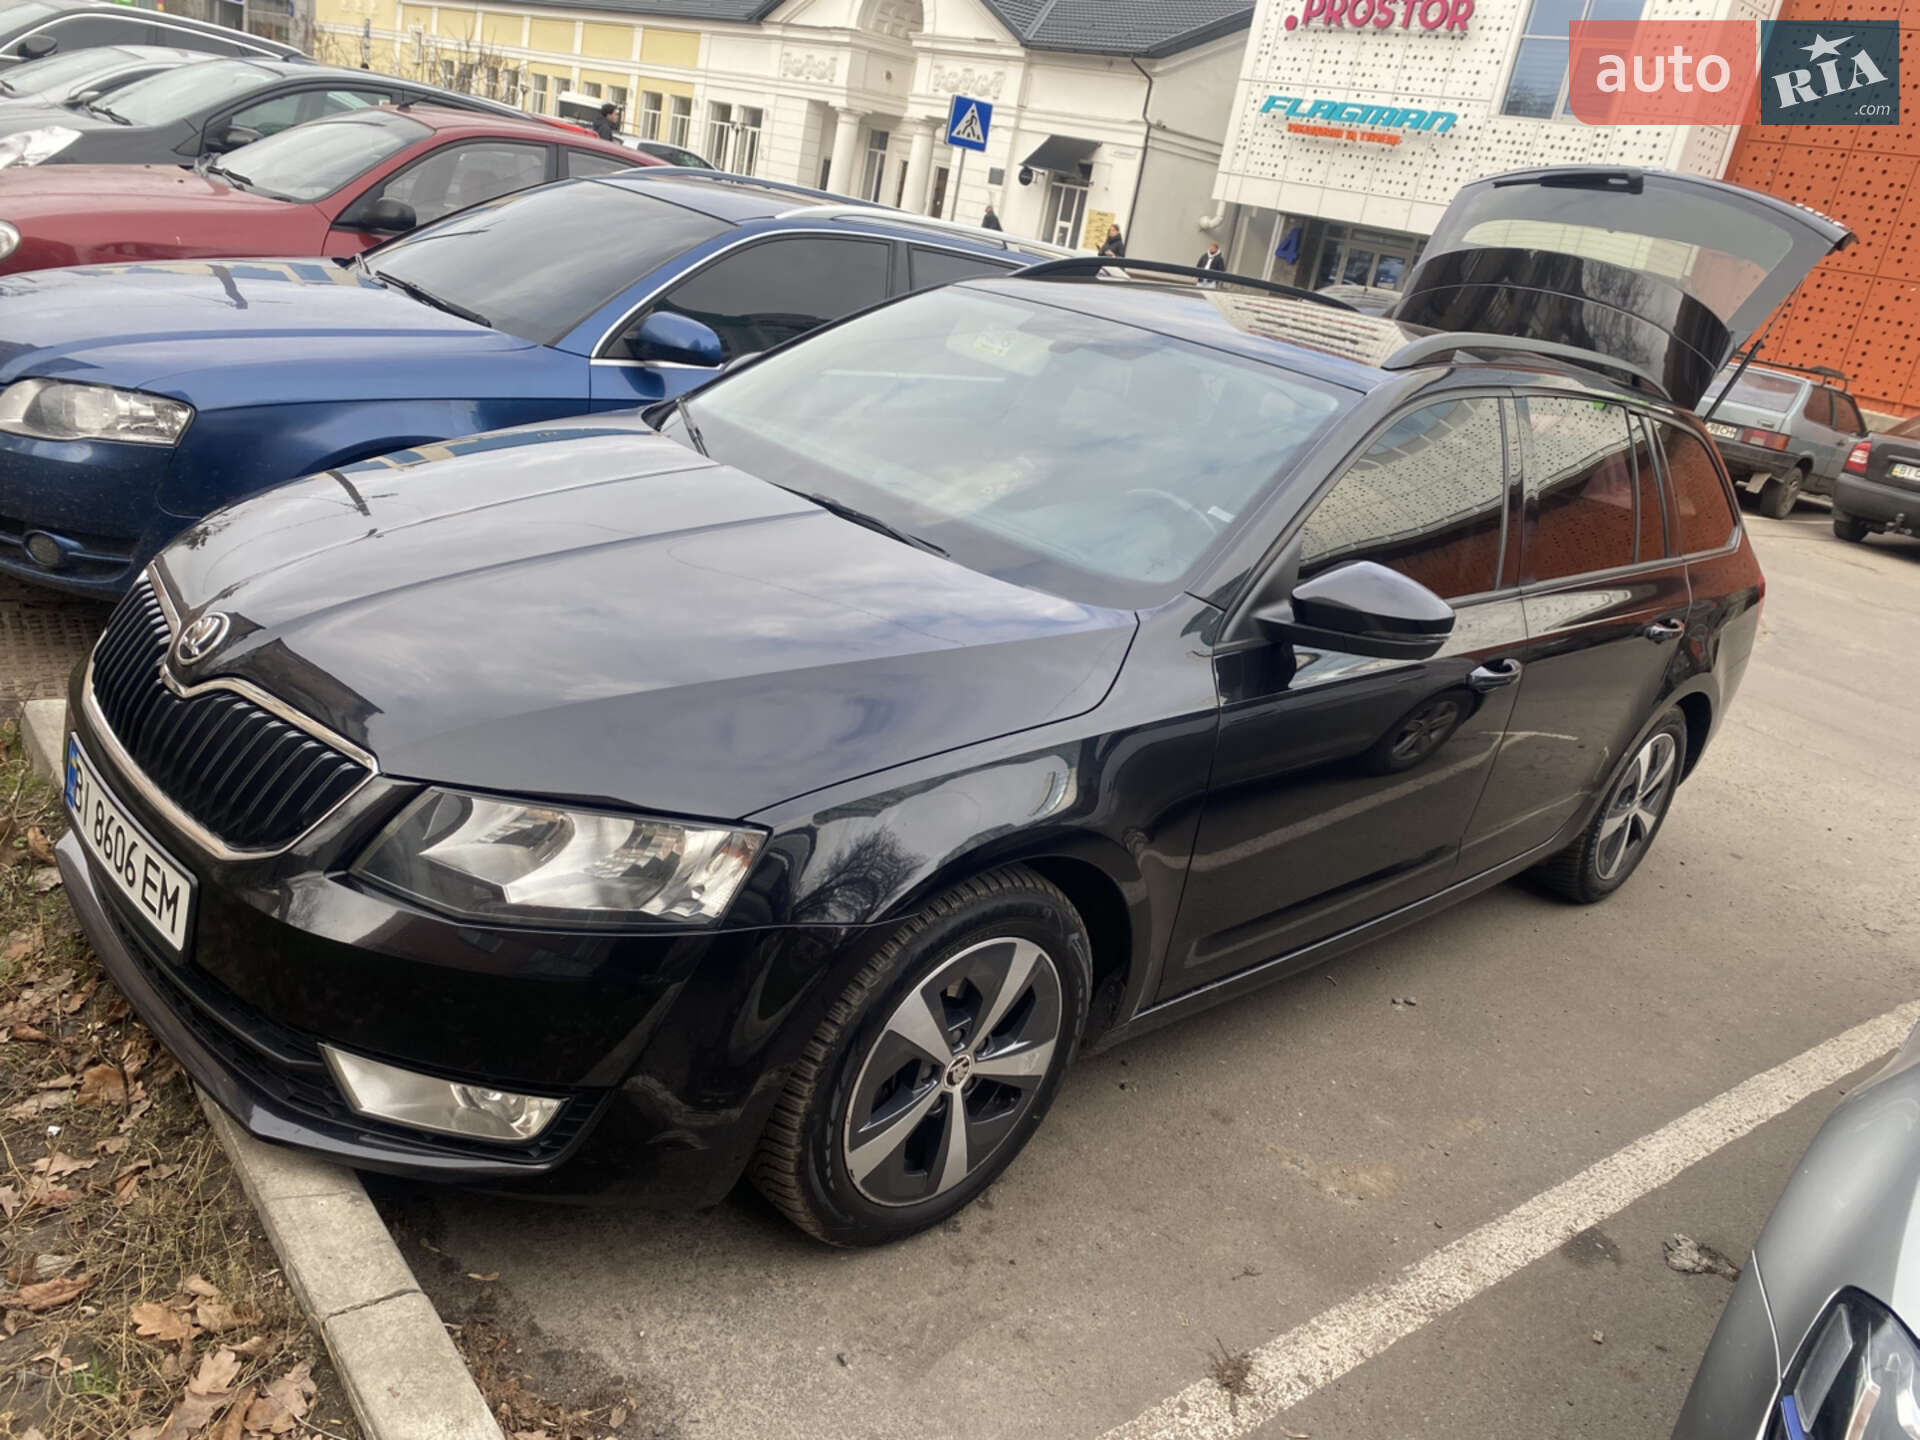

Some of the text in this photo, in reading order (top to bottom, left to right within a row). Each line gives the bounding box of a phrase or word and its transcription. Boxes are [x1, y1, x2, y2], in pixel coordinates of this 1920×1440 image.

[1260, 95, 1459, 133] FLAGMAN
[1275, 228, 1302, 265] 4
[94, 799, 138, 888] 8606
[141, 854, 180, 934] EM
